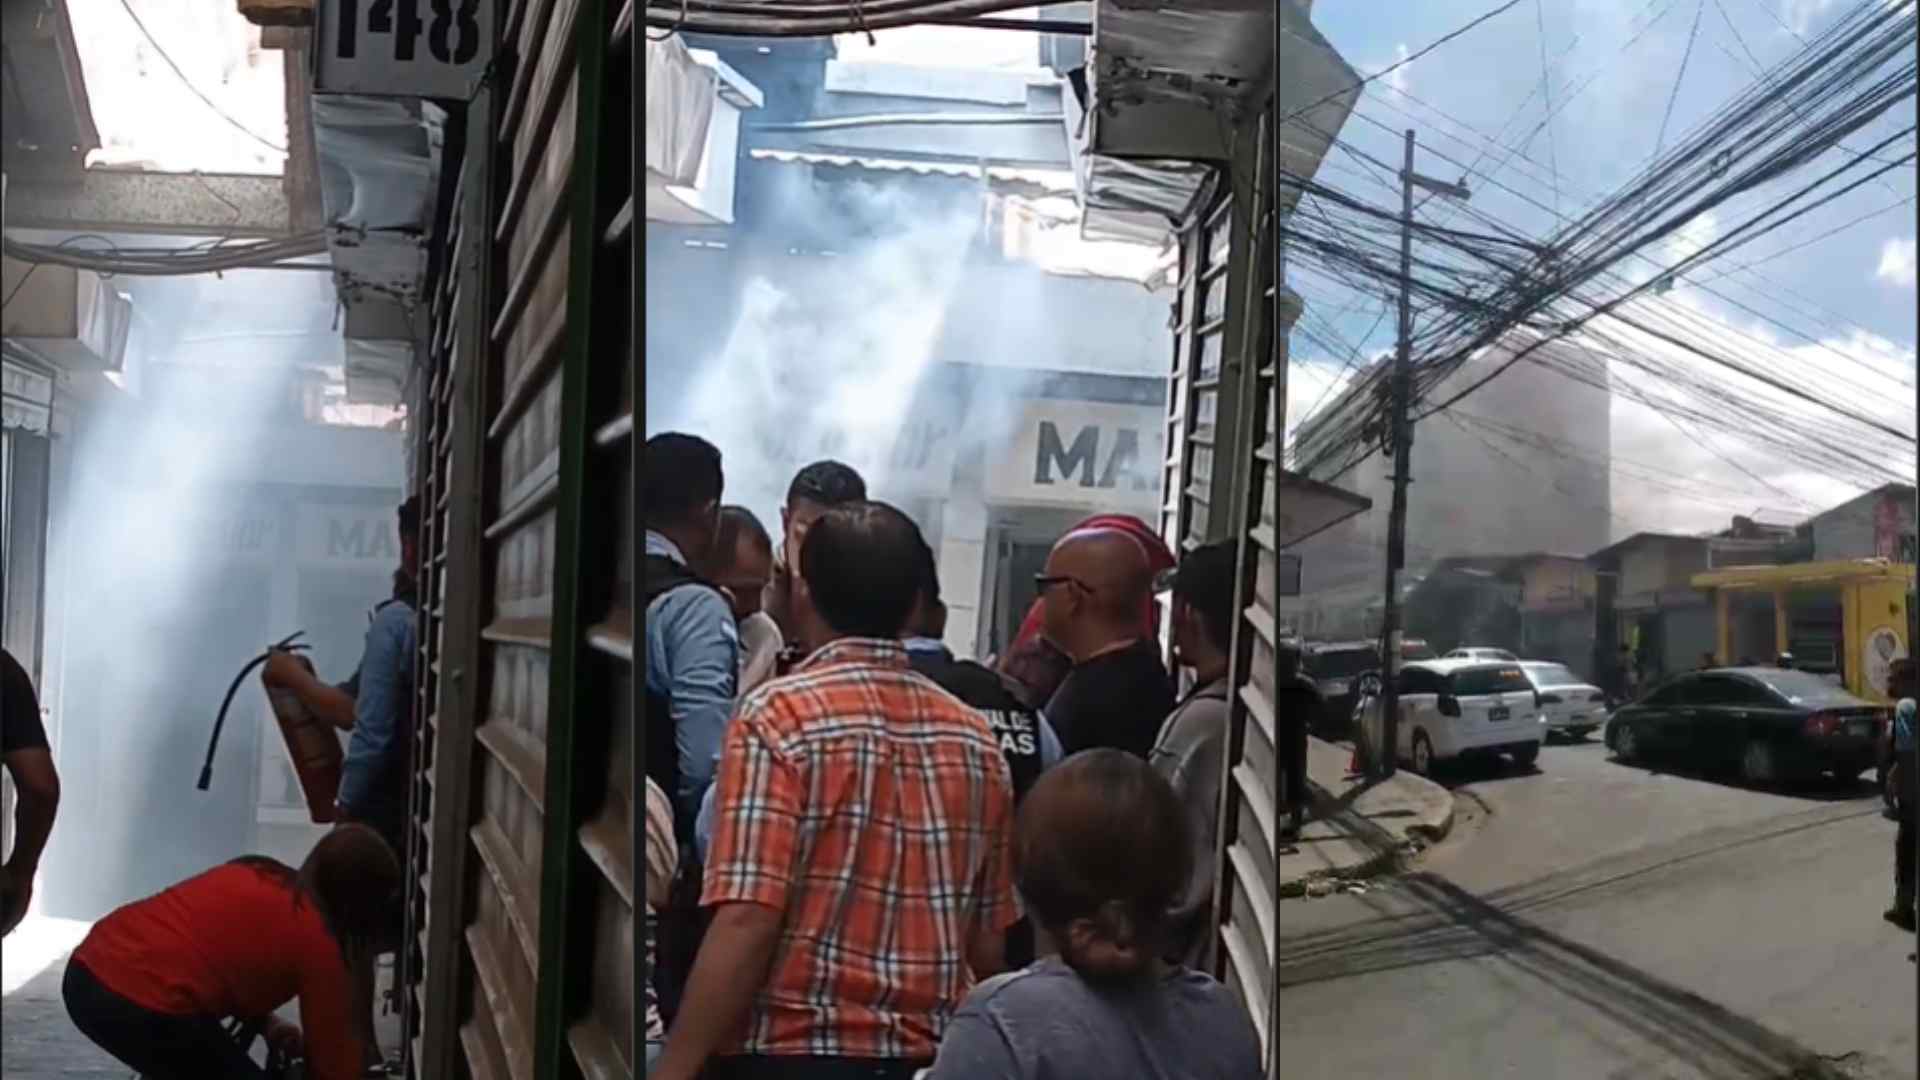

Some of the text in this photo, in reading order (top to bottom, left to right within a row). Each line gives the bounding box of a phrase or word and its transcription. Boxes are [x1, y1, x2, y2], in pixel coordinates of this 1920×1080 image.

[336, 0, 479, 65] 148
[1035, 421, 1168, 490] MA
[987, 710, 1008, 730] AL
[992, 732, 1035, 755] AS
